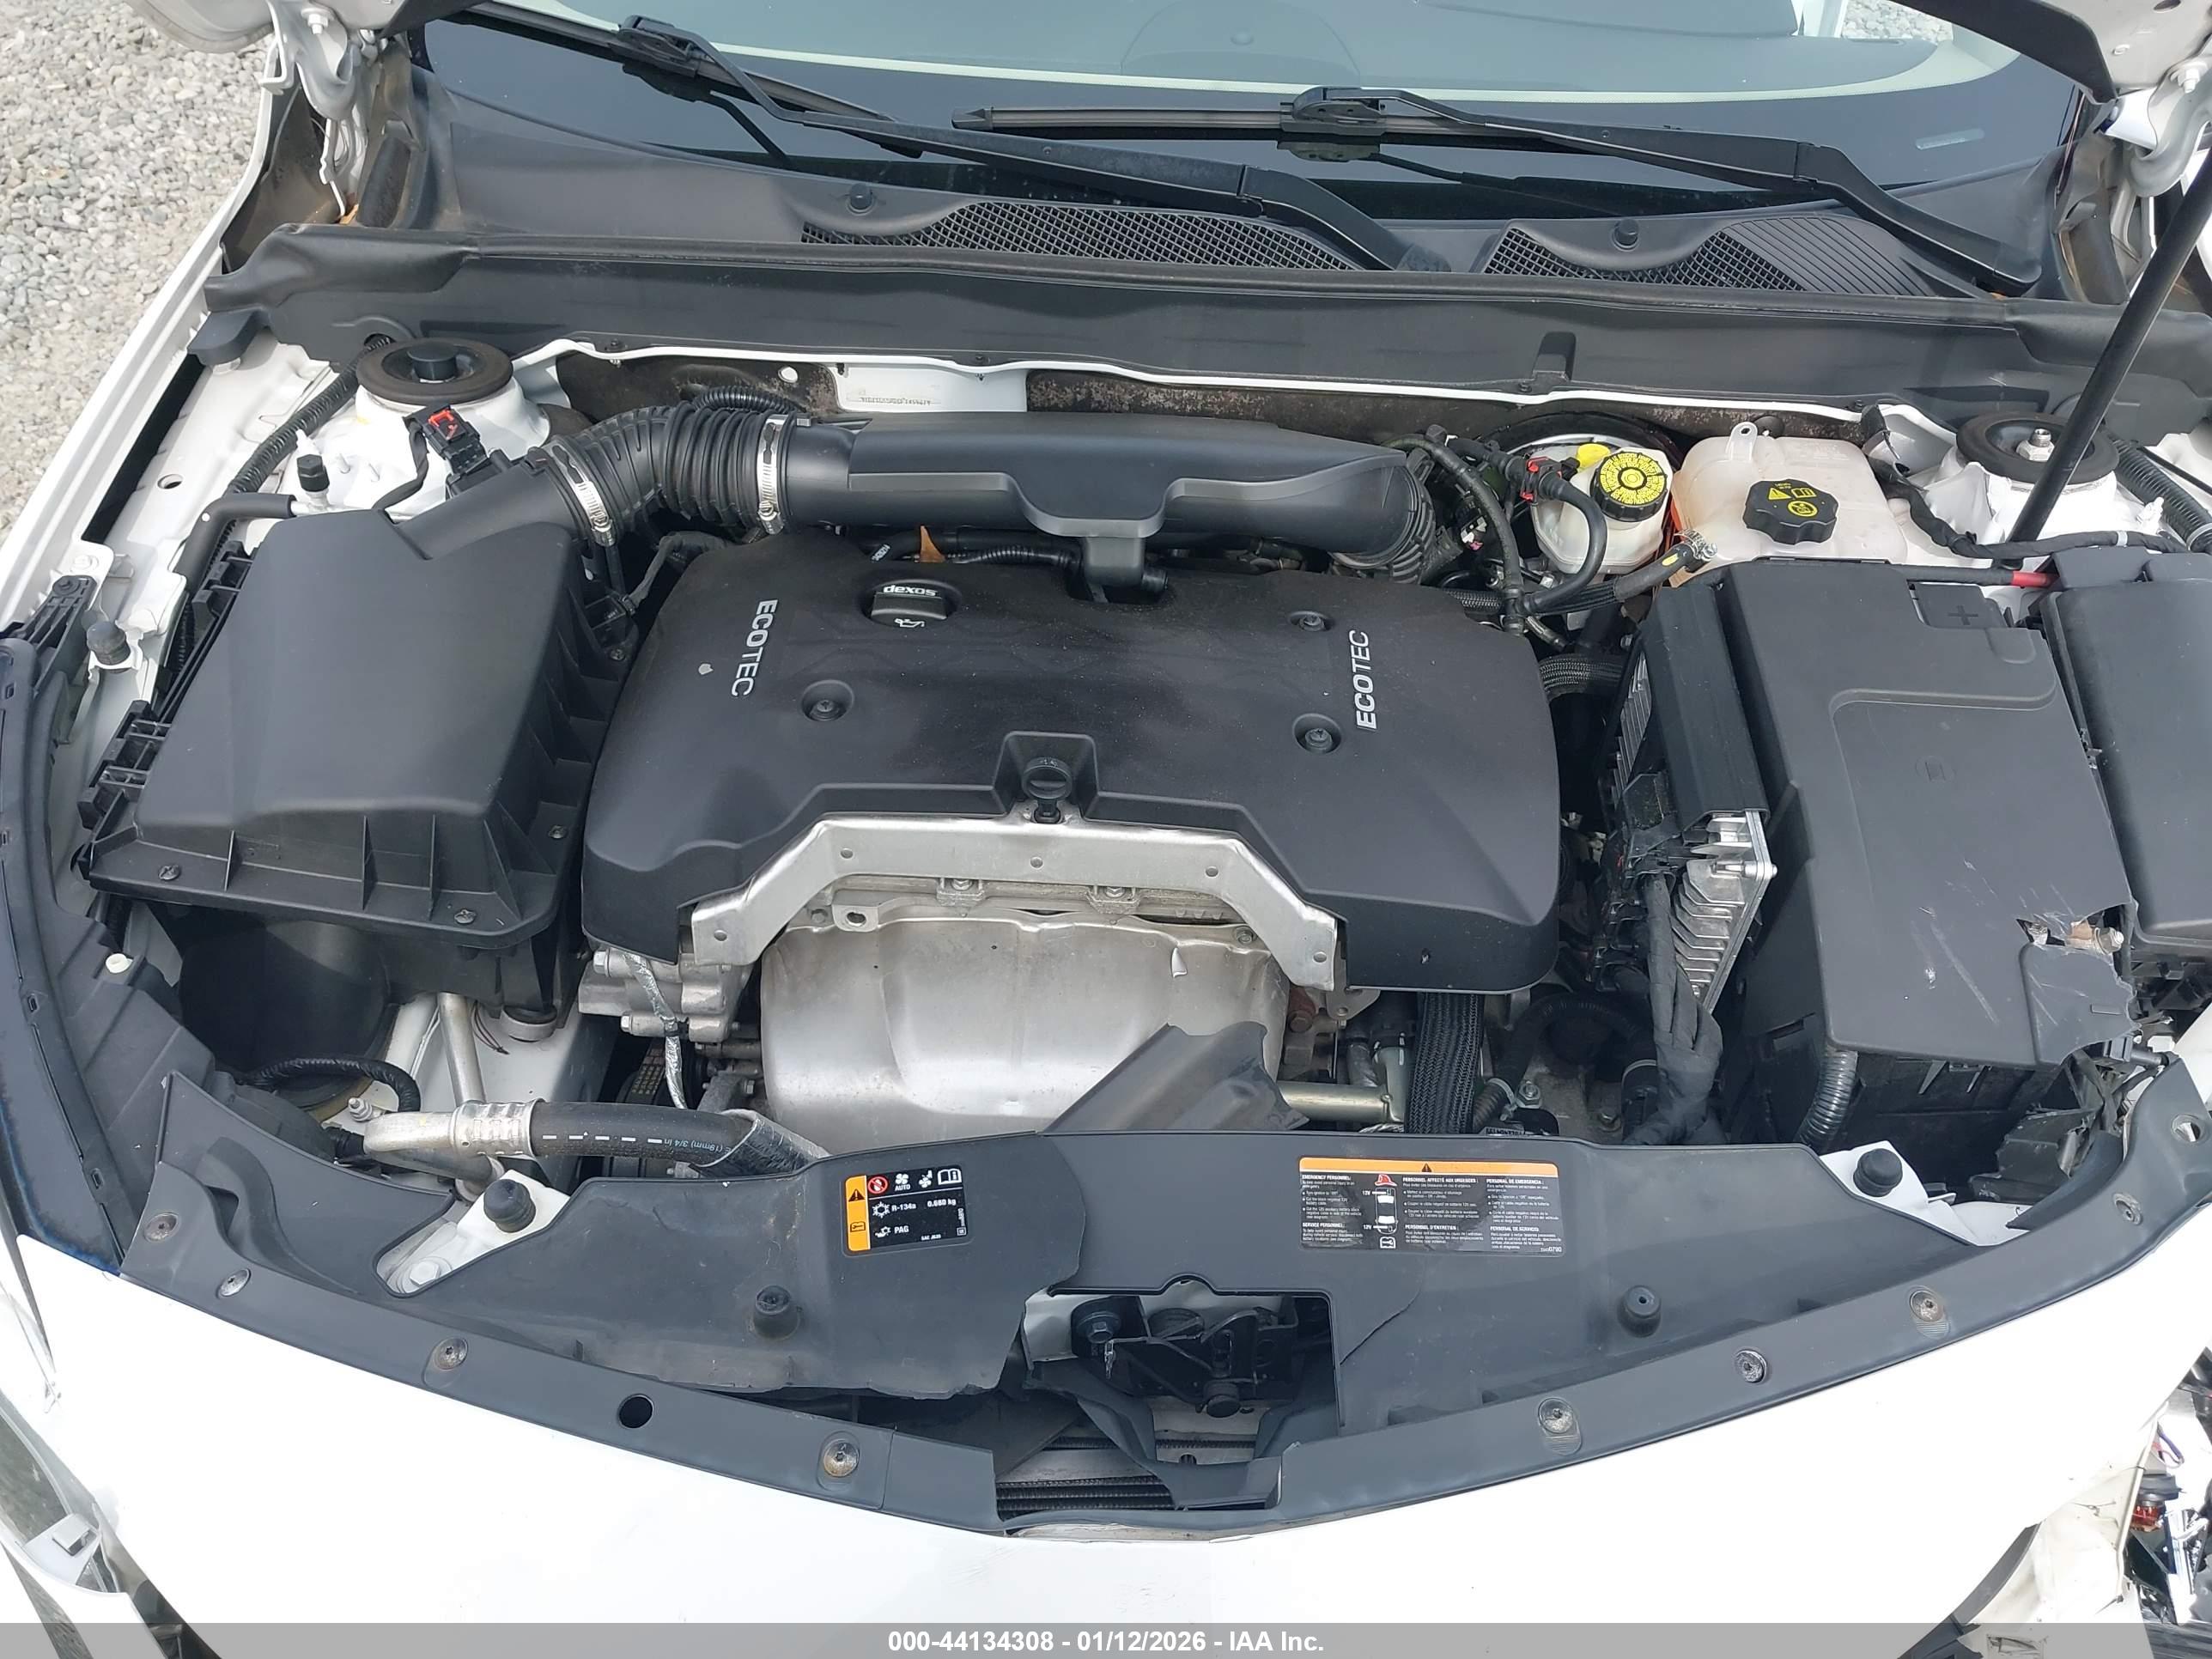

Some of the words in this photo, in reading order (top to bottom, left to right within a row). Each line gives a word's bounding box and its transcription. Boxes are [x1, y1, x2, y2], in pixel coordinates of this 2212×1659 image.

[883, 585, 938, 597] dexos
[731, 599, 779, 696] ECOTEC
[1348, 629, 1377, 730] ECOTEC
[690, 1139, 723, 1152] (19mm)
[894, 1183, 911, 1192] AUTO
[891, 1202, 916, 1212] R-134a
[947, 1197, 957, 1206] kg
[894, 1225, 909, 1234] PAG
